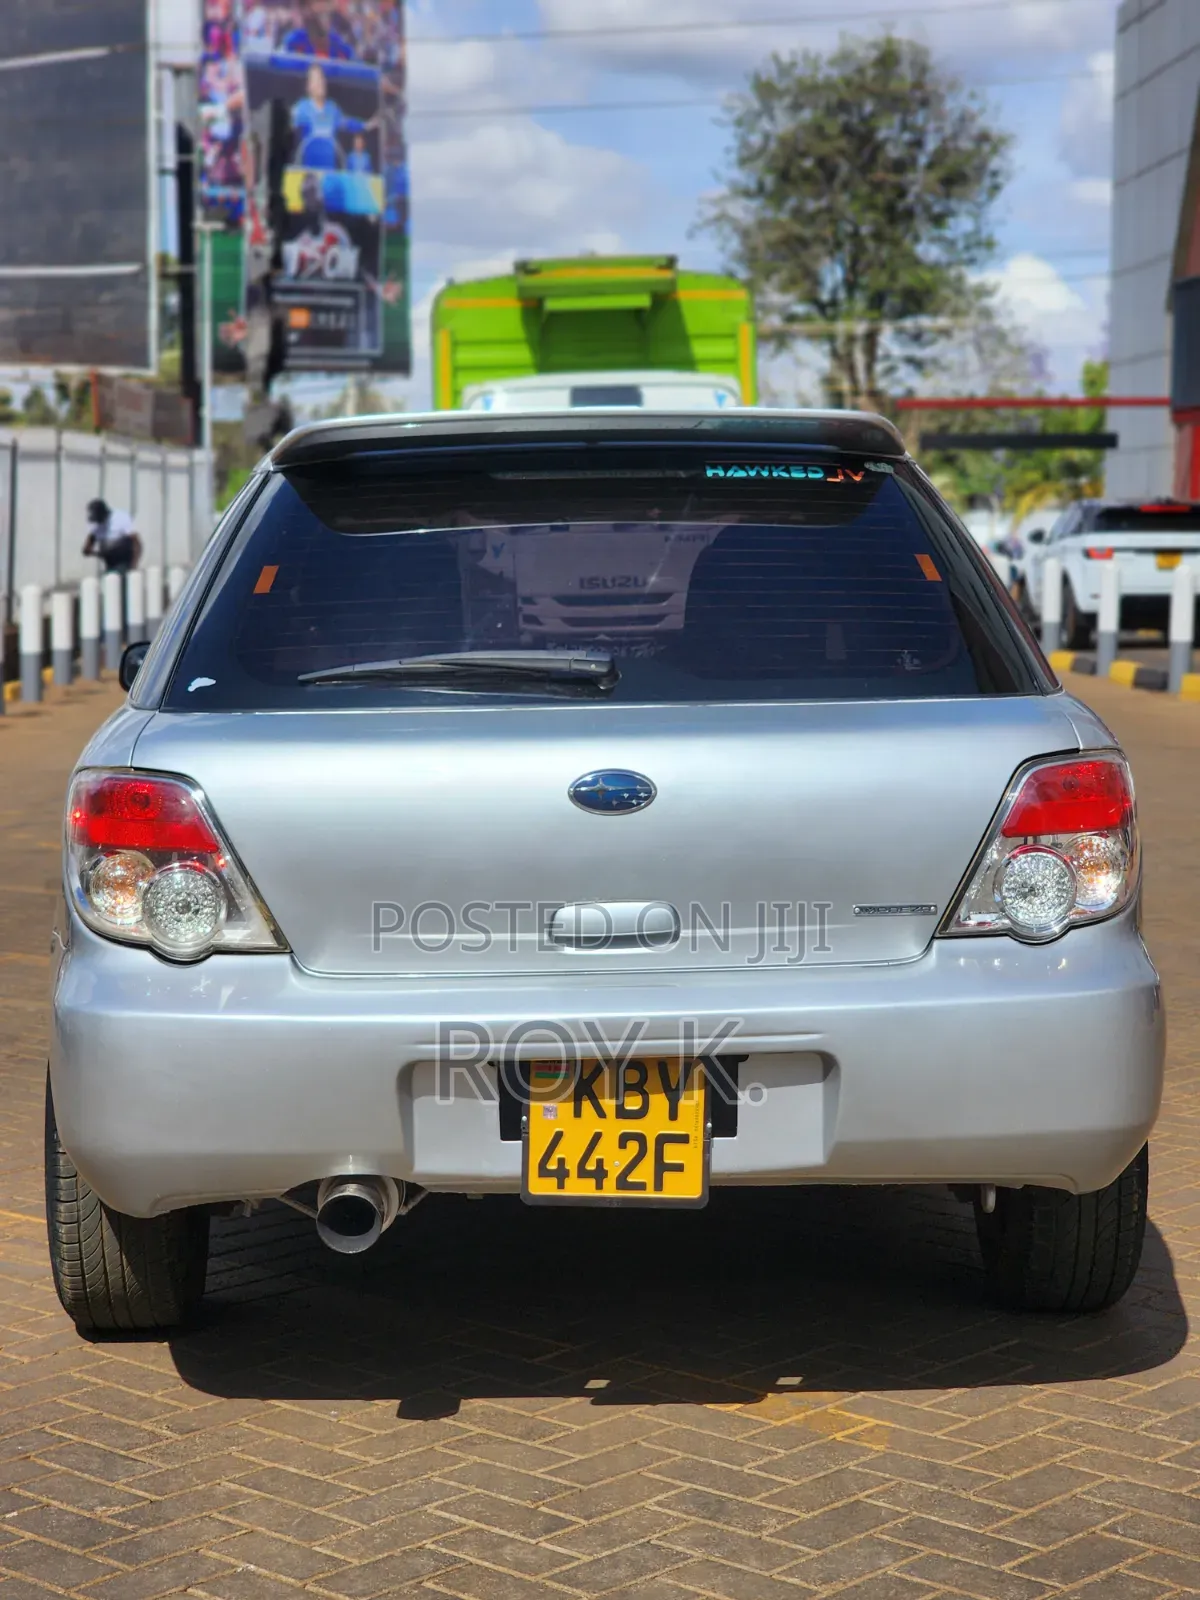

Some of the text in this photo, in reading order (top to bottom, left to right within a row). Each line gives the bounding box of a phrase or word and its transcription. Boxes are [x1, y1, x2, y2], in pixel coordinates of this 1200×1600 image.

[578, 575, 648, 590] ISUZU
[573, 1059, 692, 1121] KBY
[538, 1130, 690, 1192] 442F
